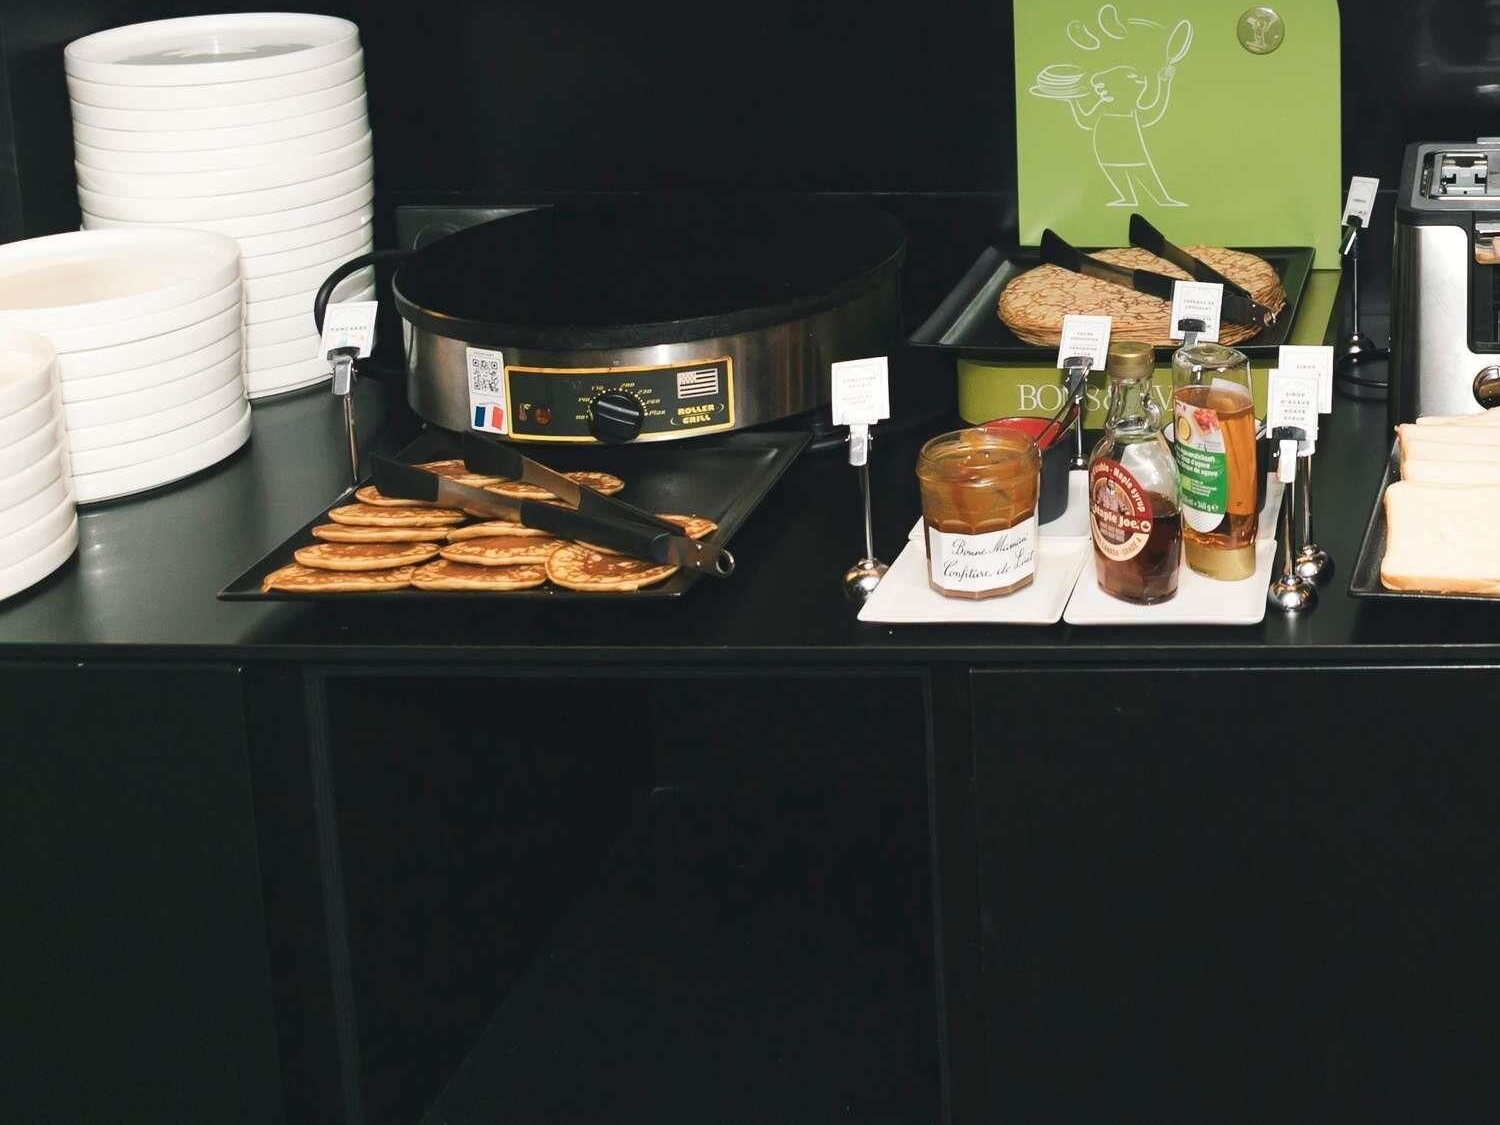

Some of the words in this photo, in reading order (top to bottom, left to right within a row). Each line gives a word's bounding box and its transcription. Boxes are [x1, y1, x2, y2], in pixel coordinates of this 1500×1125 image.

[677, 404, 715, 416] ROLLER
[682, 414, 711, 425] GRILL
[952, 538, 988, 556] Bonne
[992, 533, 1028, 553] Maman
[943, 559, 991, 582] Confiture
